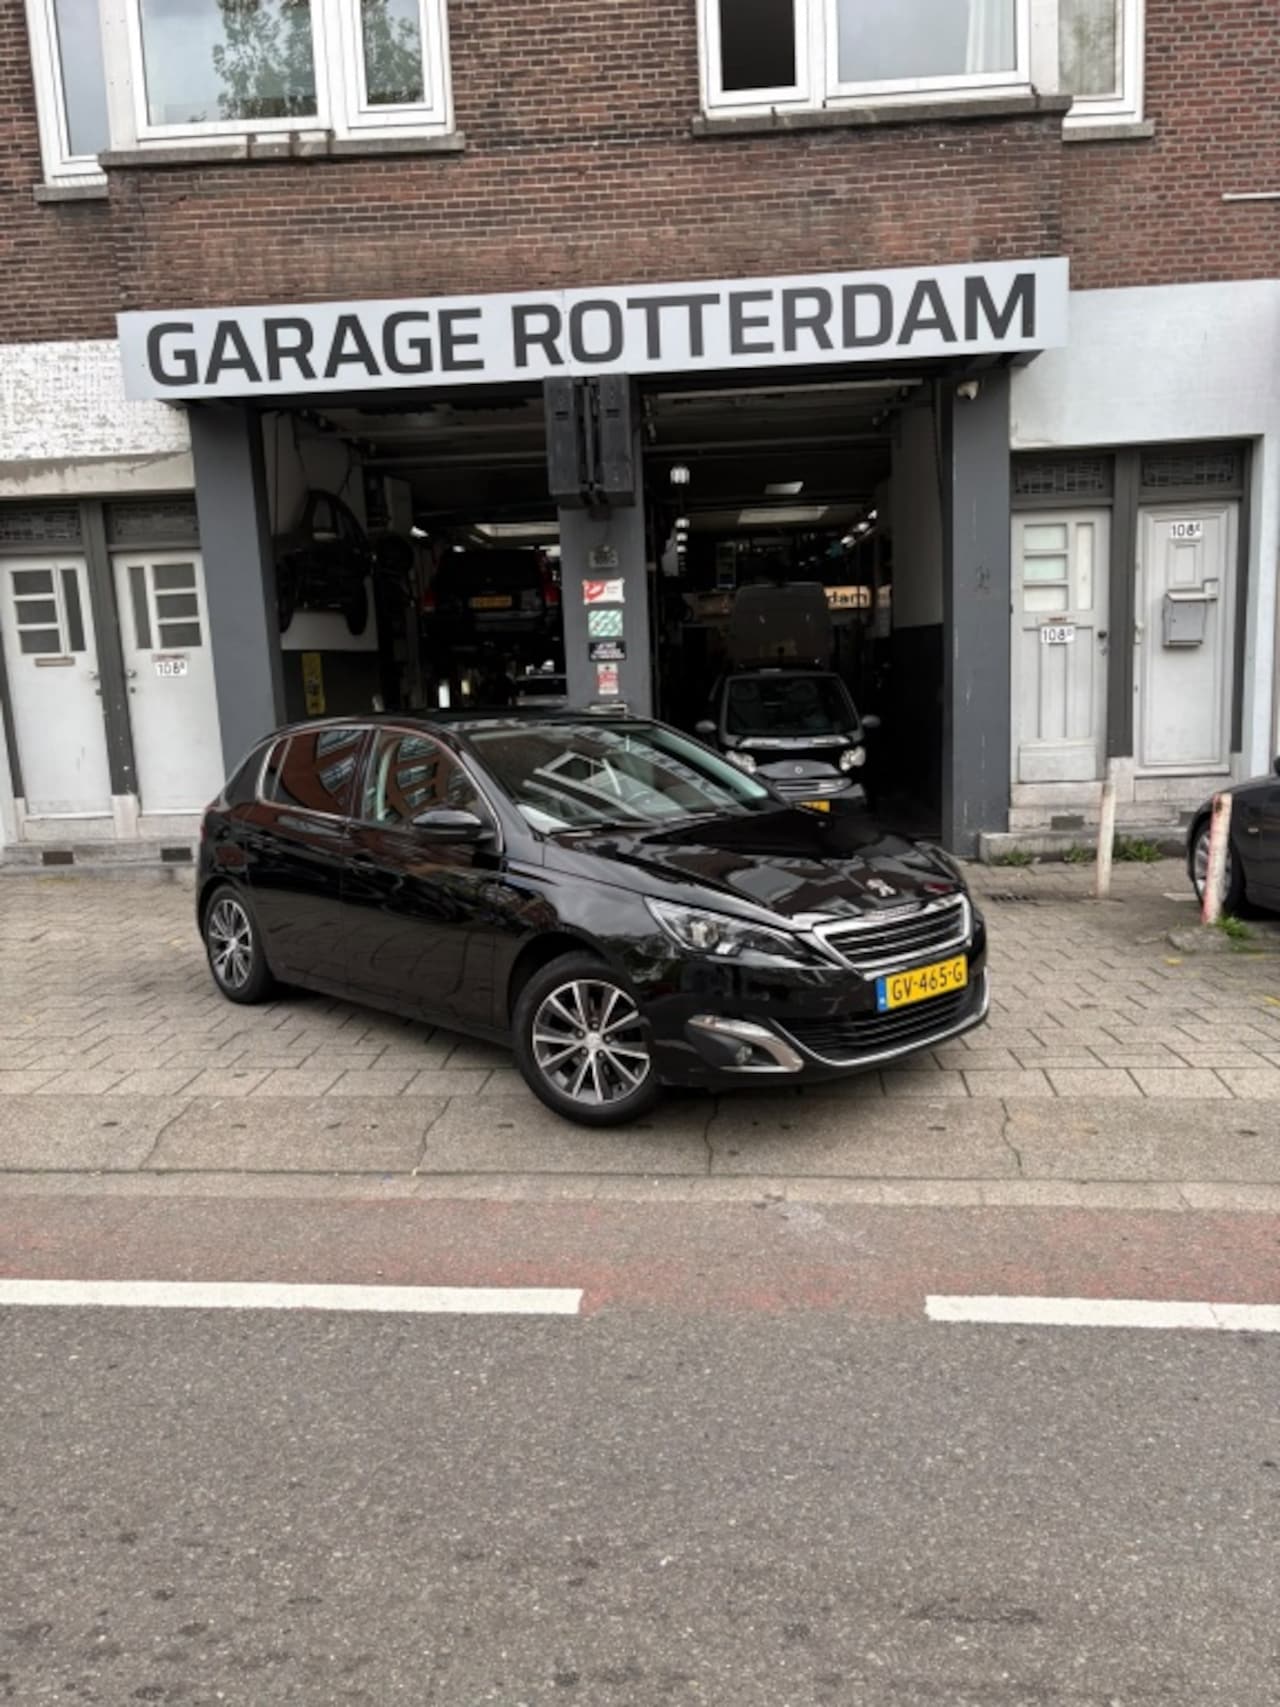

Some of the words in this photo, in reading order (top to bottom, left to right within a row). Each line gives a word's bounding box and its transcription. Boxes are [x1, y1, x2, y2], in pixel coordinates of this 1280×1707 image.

[147, 308, 485, 387] GARAGE
[511, 273, 1037, 368] ROTTERDAM
[892, 962, 963, 1001] GV-465-G
